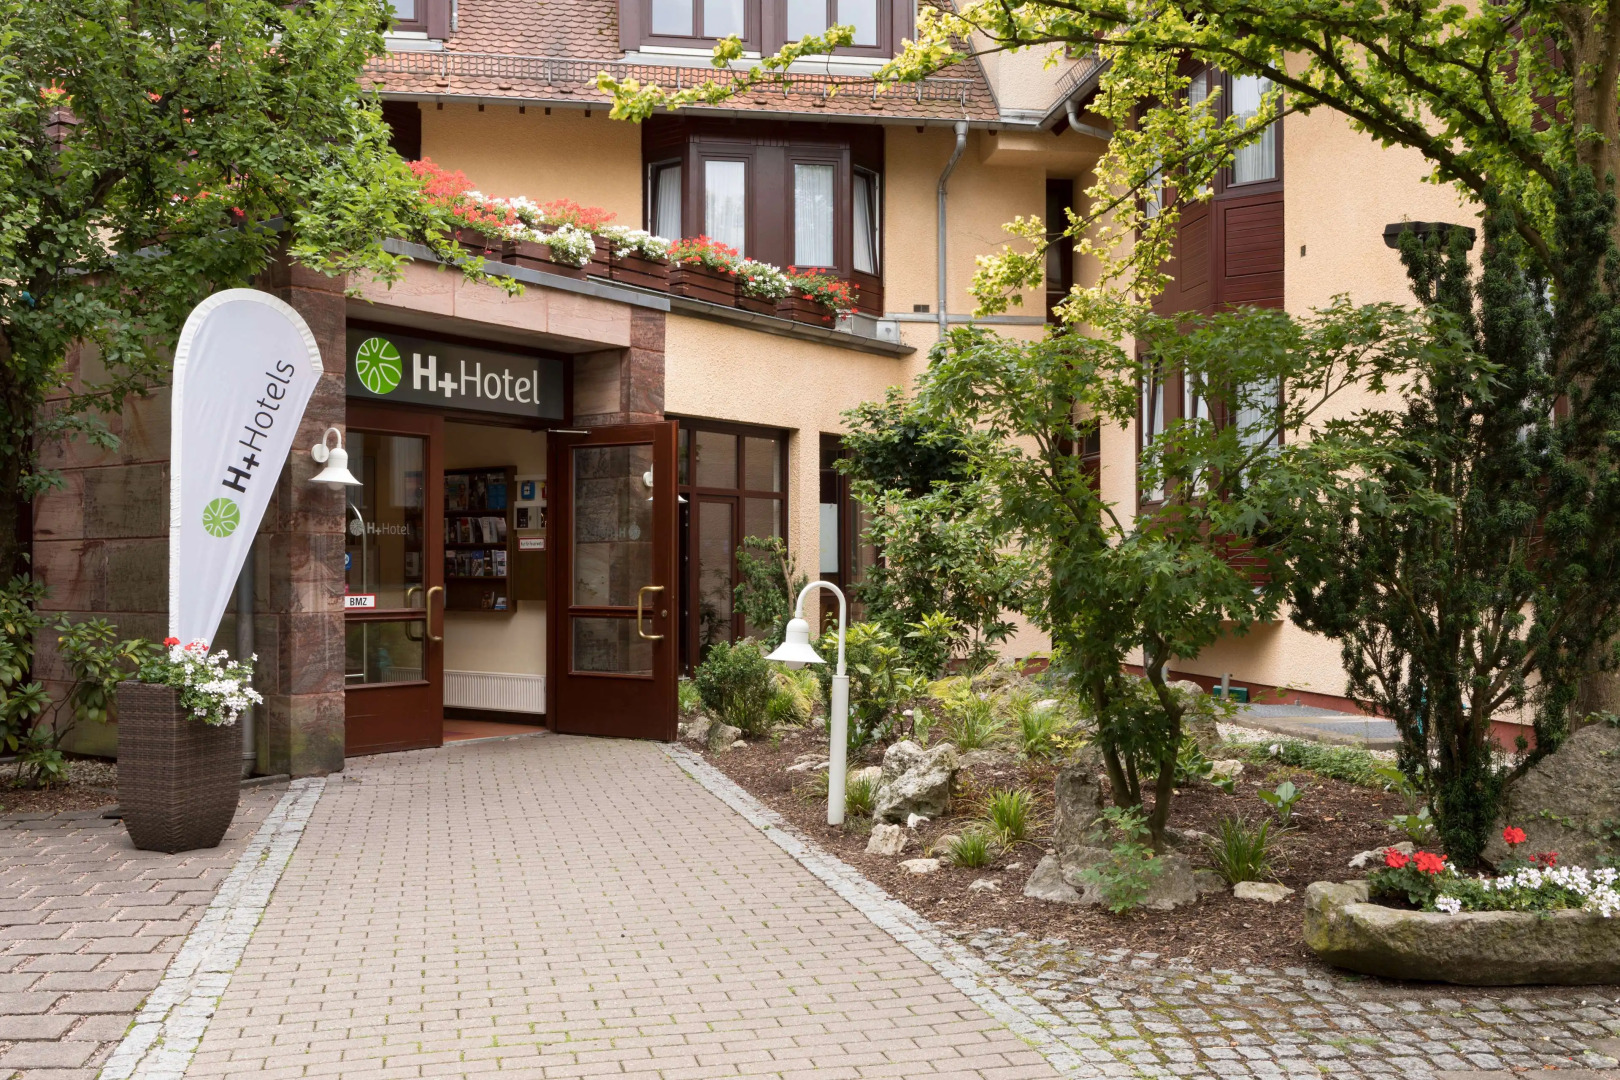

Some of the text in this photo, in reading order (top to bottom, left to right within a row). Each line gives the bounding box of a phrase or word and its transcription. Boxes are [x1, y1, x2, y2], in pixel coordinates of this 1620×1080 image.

[413, 353, 540, 405] H+Hotel
[222, 360, 294, 493] H+Hotels
[367, 522, 410, 535] H+Hotel
[349, 597, 368, 606] BMZ
